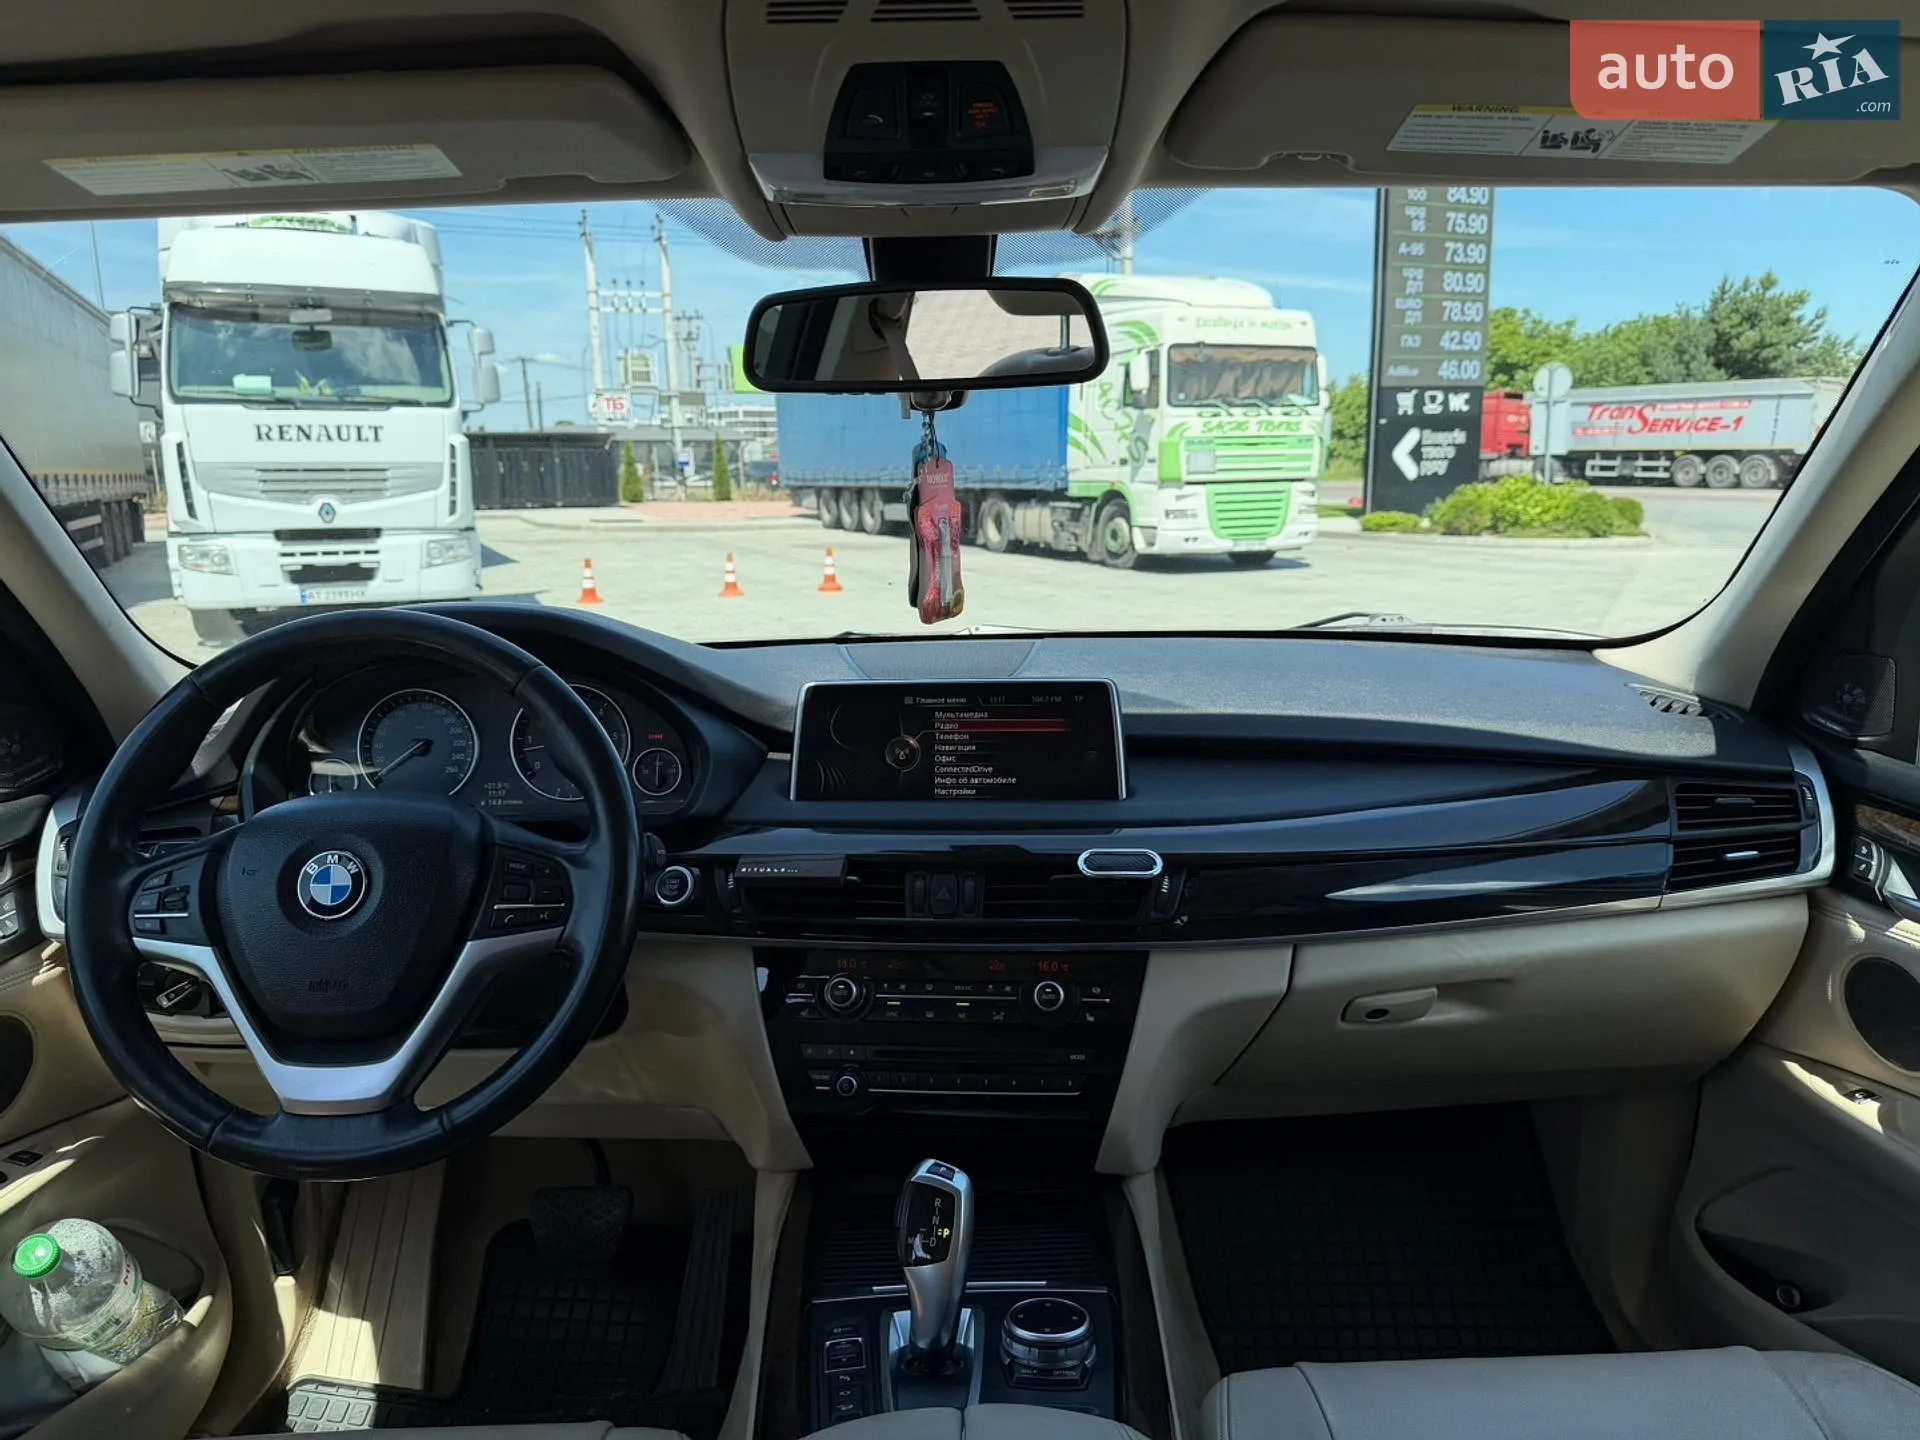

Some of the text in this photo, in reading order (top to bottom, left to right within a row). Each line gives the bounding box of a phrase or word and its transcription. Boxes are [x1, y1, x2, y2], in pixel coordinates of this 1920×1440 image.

[1452, 104, 1521, 113] WARNING
[1446, 187, 1489, 204] 84.90
[1446, 211, 1488, 235] 75.90
[1444, 242, 1486, 264] 73.90
[1443, 271, 1485, 293] 80.90
[1442, 301, 1483, 322] 78.90
[1439, 330, 1481, 351] 42.90
[1438, 359, 1480, 380] 46.00
[1448, 391, 1471, 412] WC
[254, 423, 385, 443] RENAULT
[934, 711, 989, 719] Мультимедиа
[934, 722, 959, 730] Радио
[935, 733, 969, 741] Телефон
[935, 744, 976, 752] Навигация
[934, 755, 956, 763] Офис
[934, 765, 993, 773] ConnectedDrive
[934, 776, 957, 785] Инфо
[958, 776, 968, 784] об
[934, 787, 976, 796] Настройки
[306, 854, 359, 875] BMW
[934, 1198, 941, 1207] R
[932, 1216, 939, 1225] N
[943, 1228, 950, 1238] P
[930, 1237, 937, 1246] D
